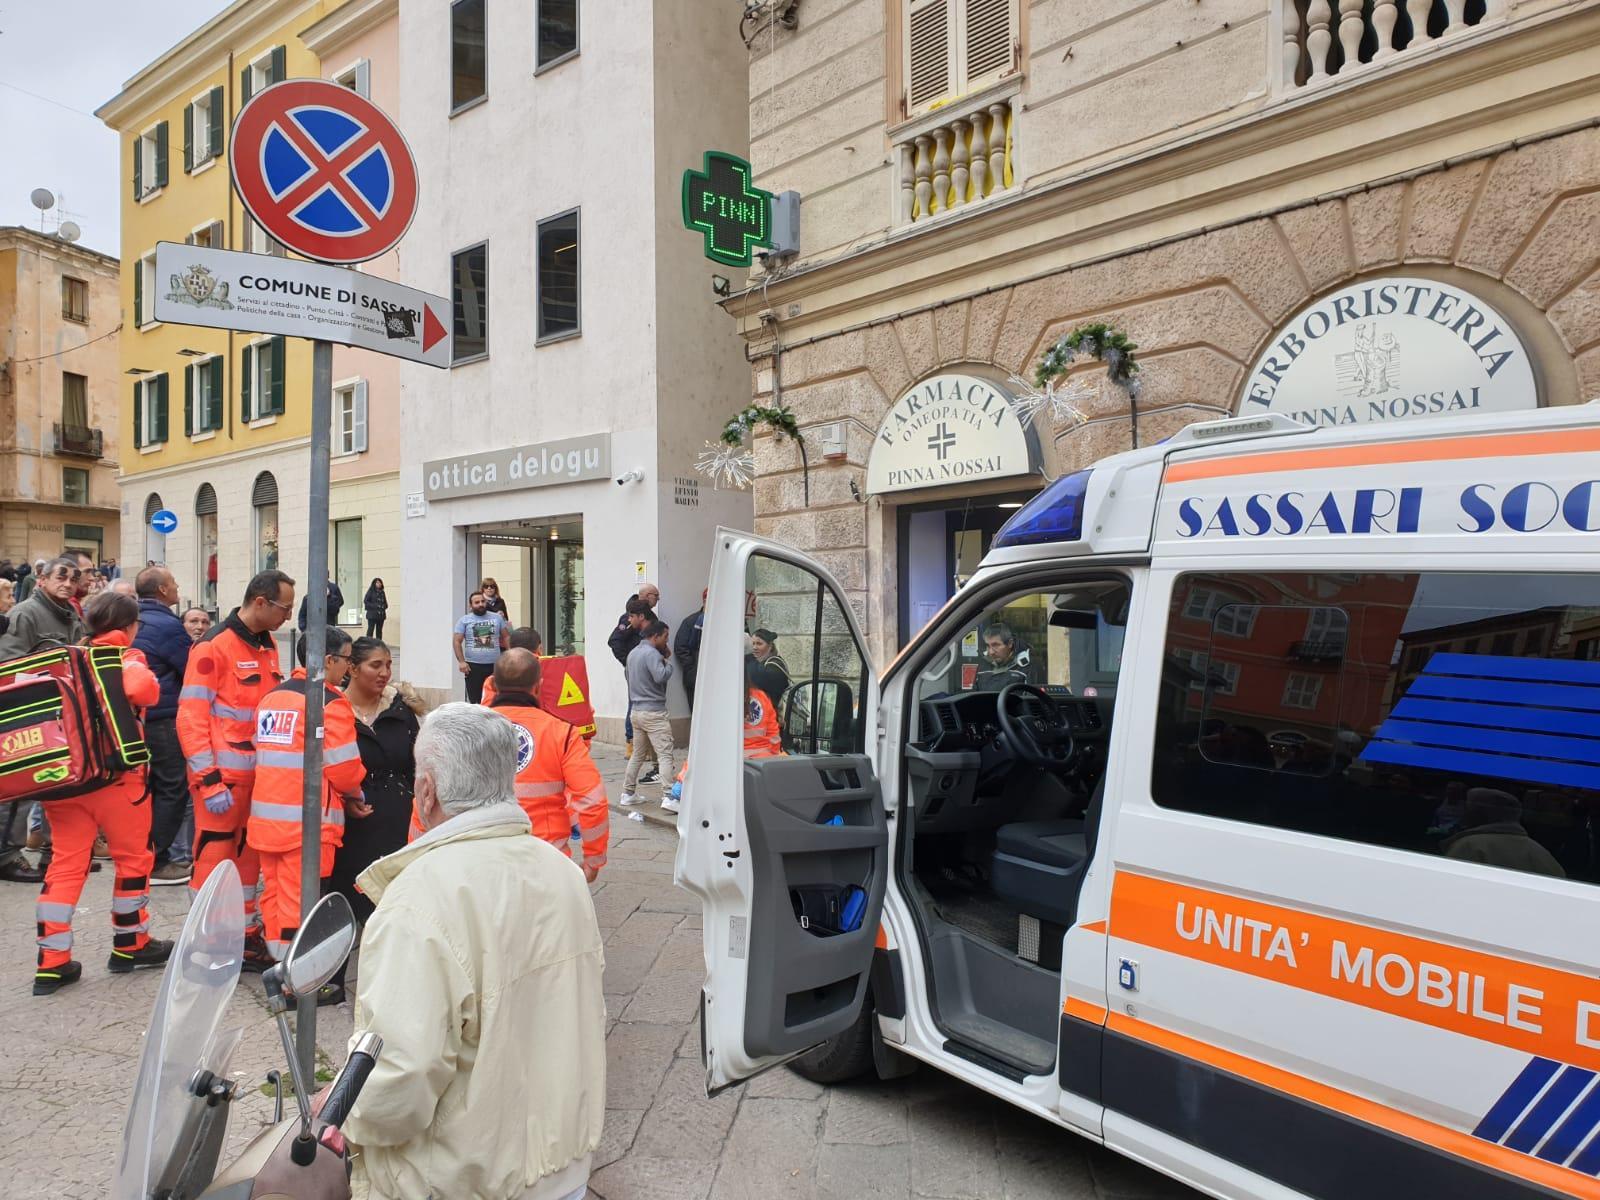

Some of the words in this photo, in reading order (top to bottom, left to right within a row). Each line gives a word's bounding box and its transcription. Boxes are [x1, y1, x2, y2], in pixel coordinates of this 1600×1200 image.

[703, 191, 755, 225] PINN
[237, 296, 261, 304] Servizi
[270, 301, 300, 310] cittadino
[306, 305, 326, 313] Punto
[239, 275, 331, 301] COMUNE
[337, 289, 356, 304] DI
[237, 306, 267, 314] Politiche
[269, 309, 285, 317] della
[307, 314, 356, 328] Organizzazione
[1248, 284, 1514, 408] ERBORISTERIA
[880, 379, 1008, 448] FARMACIA
[903, 406, 984, 442] OMEOPATIA
[1284, 405, 1357, 426] INNA
[1368, 386, 1481, 422] NOSSAI
[429, 460, 498, 491] ottica
[509, 447, 600, 480] delogu
[888, 466, 936, 486] PINNA
[940, 455, 1003, 480] NOSSAI
[1176, 487, 1423, 538] SASSARI
[1176, 901, 1310, 969] UNITA'
[1330, 940, 1545, 1035] MOBILE
